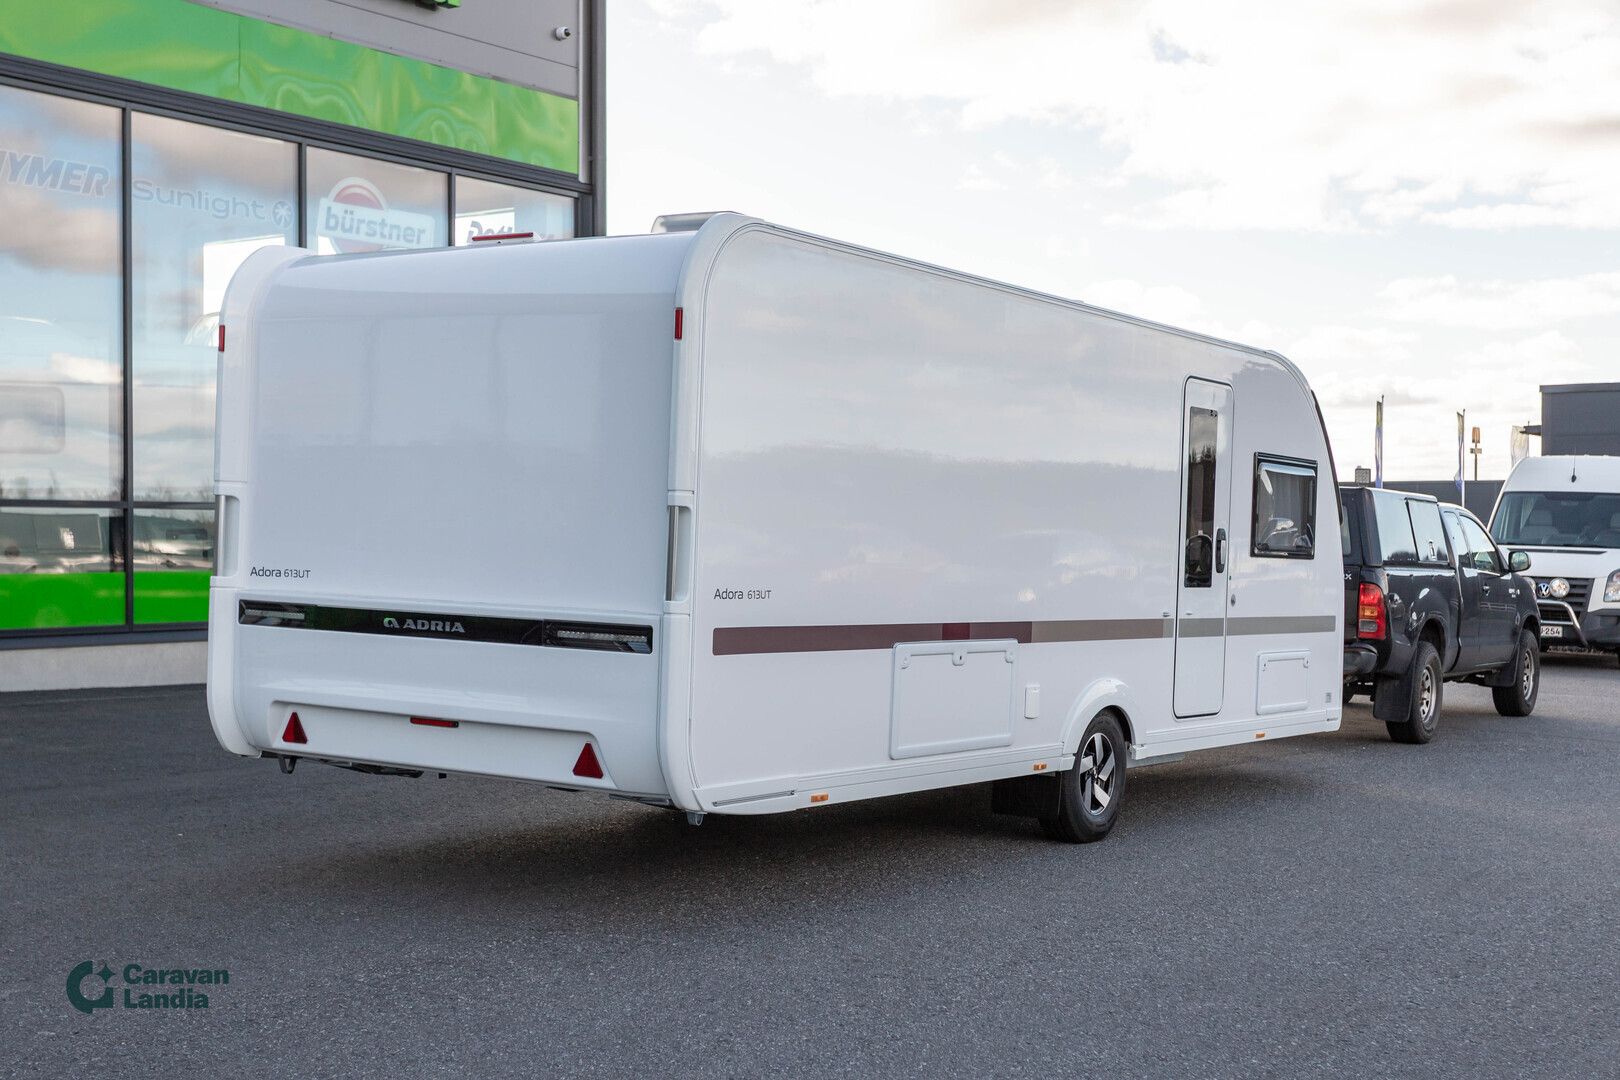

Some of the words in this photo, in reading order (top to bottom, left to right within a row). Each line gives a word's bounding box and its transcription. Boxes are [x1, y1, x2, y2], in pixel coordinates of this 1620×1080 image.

[0, 150, 110, 197] YMER
[132, 180, 266, 220] Sunlight
[325, 206, 426, 245] bürstner
[250, 566, 282, 578] Adora
[283, 568, 311, 579] 613UT
[713, 588, 744, 600] Adora
[747, 589, 772, 600] 613UT
[403, 619, 465, 633] ADRIA
